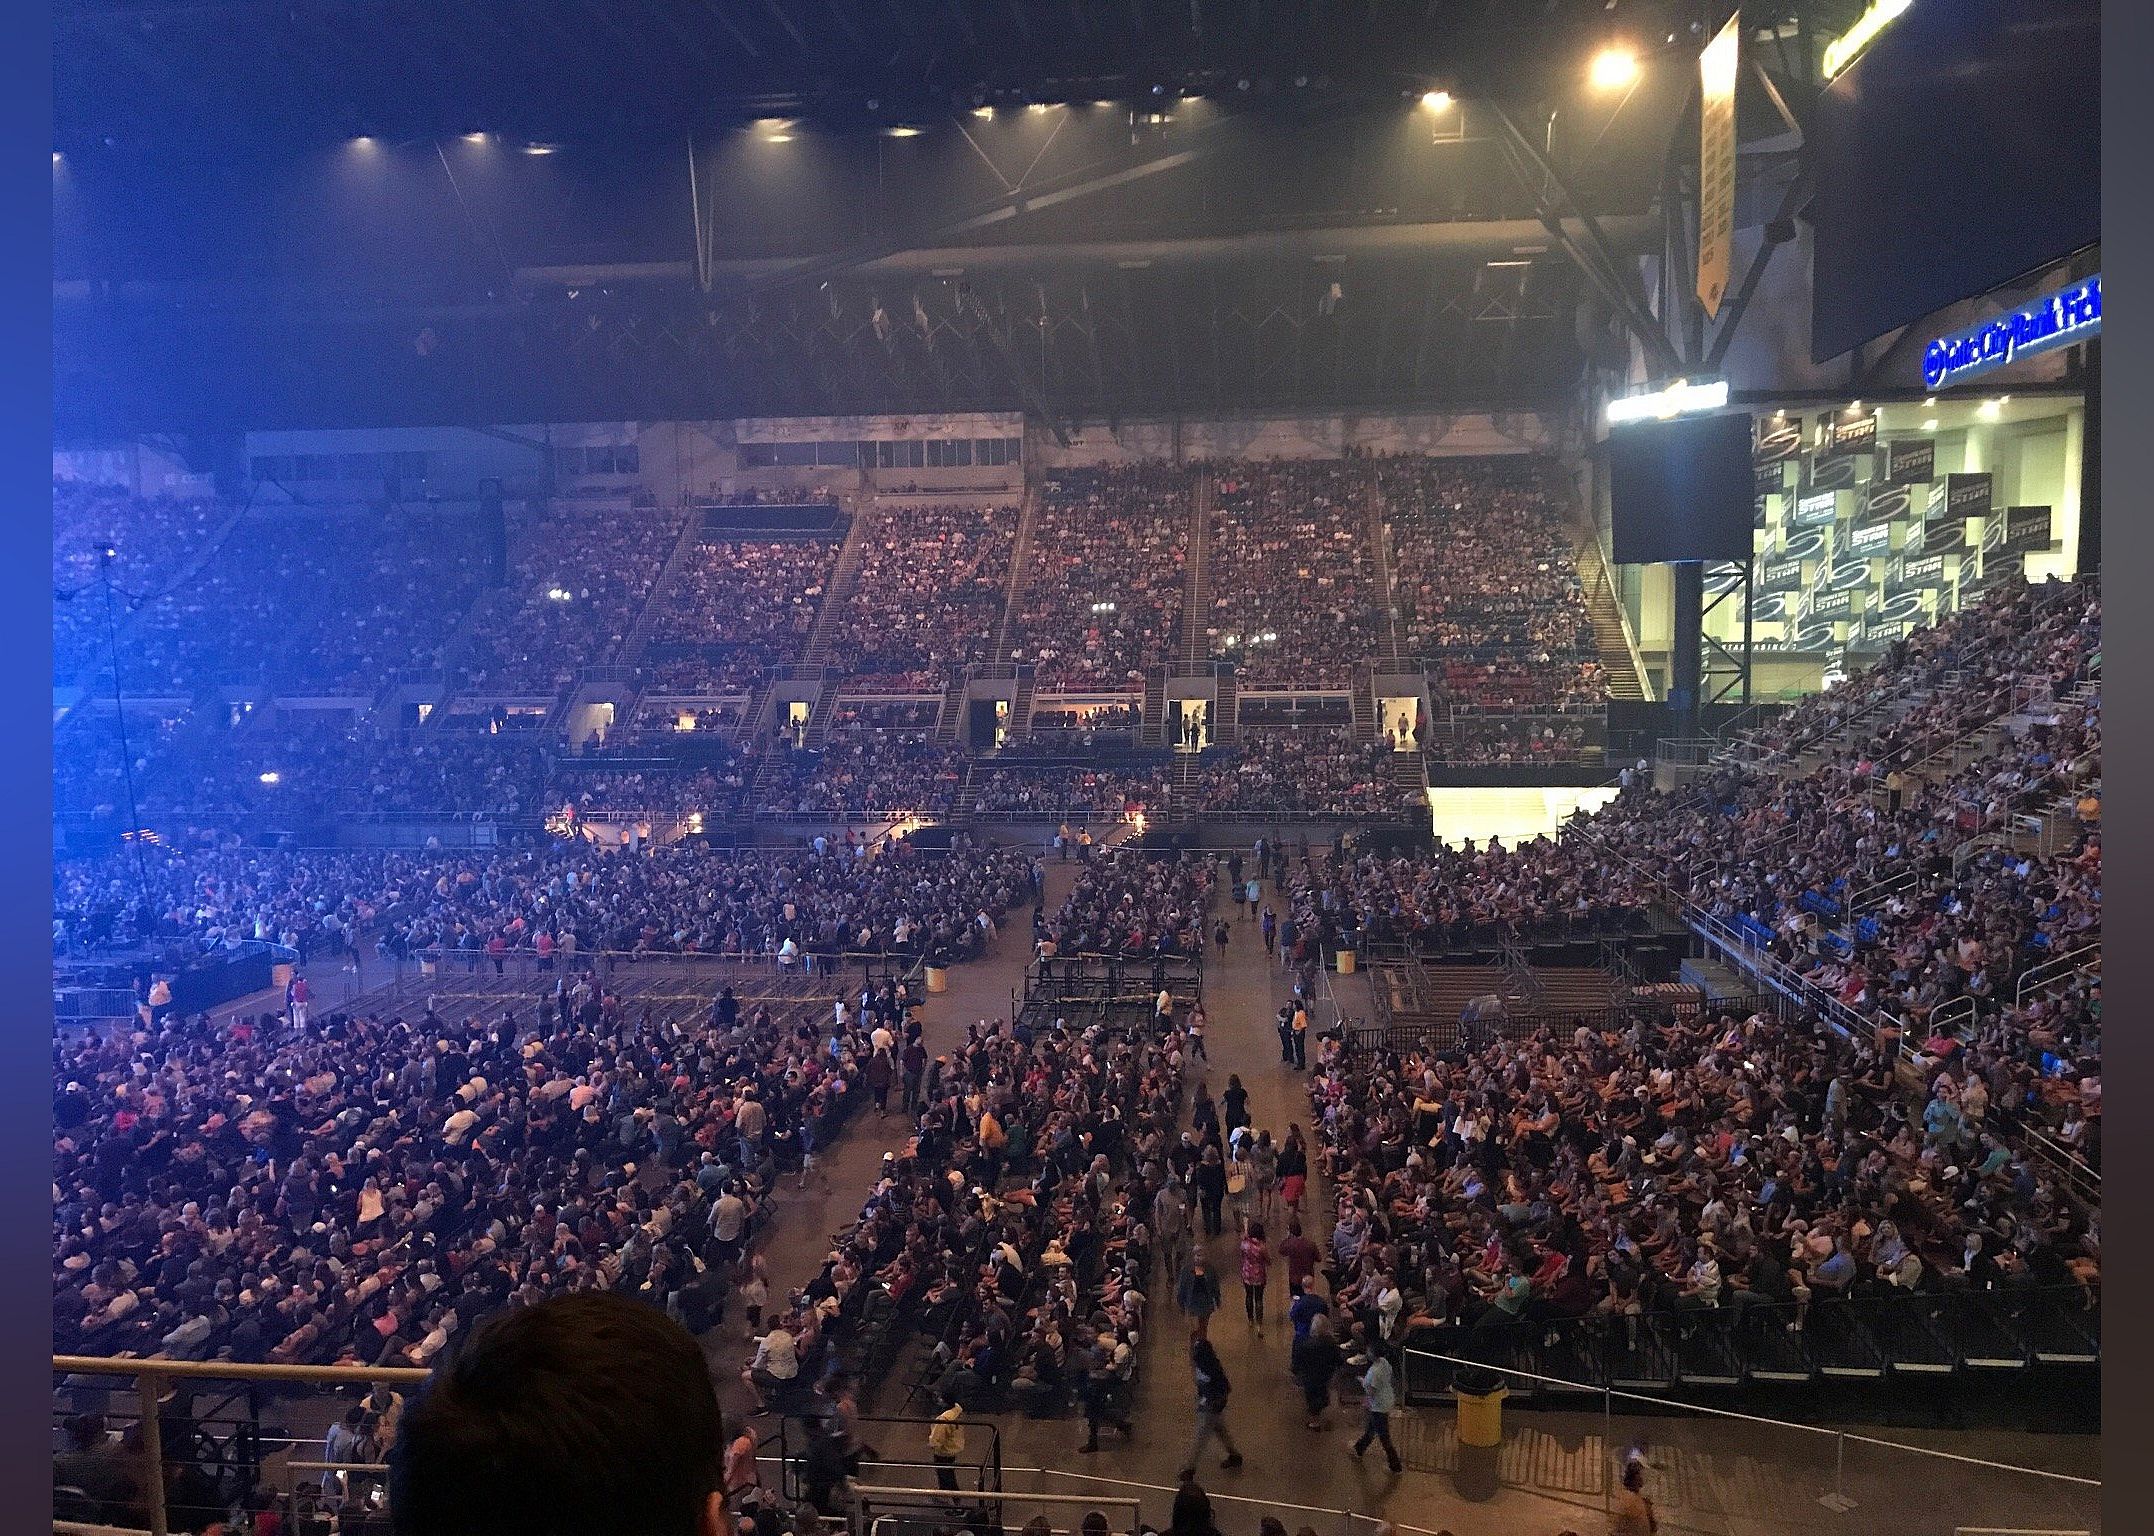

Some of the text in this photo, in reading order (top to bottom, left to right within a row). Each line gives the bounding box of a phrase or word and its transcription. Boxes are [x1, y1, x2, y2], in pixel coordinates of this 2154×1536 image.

[1979, 322, 2014, 363] City
[2010, 297, 2063, 350] Bank
[2060, 278, 2102, 330] Fiel
[1766, 565, 1800, 581] STAR
[1904, 561, 1942, 579] STAR
[1815, 595, 1850, 612] STAR
